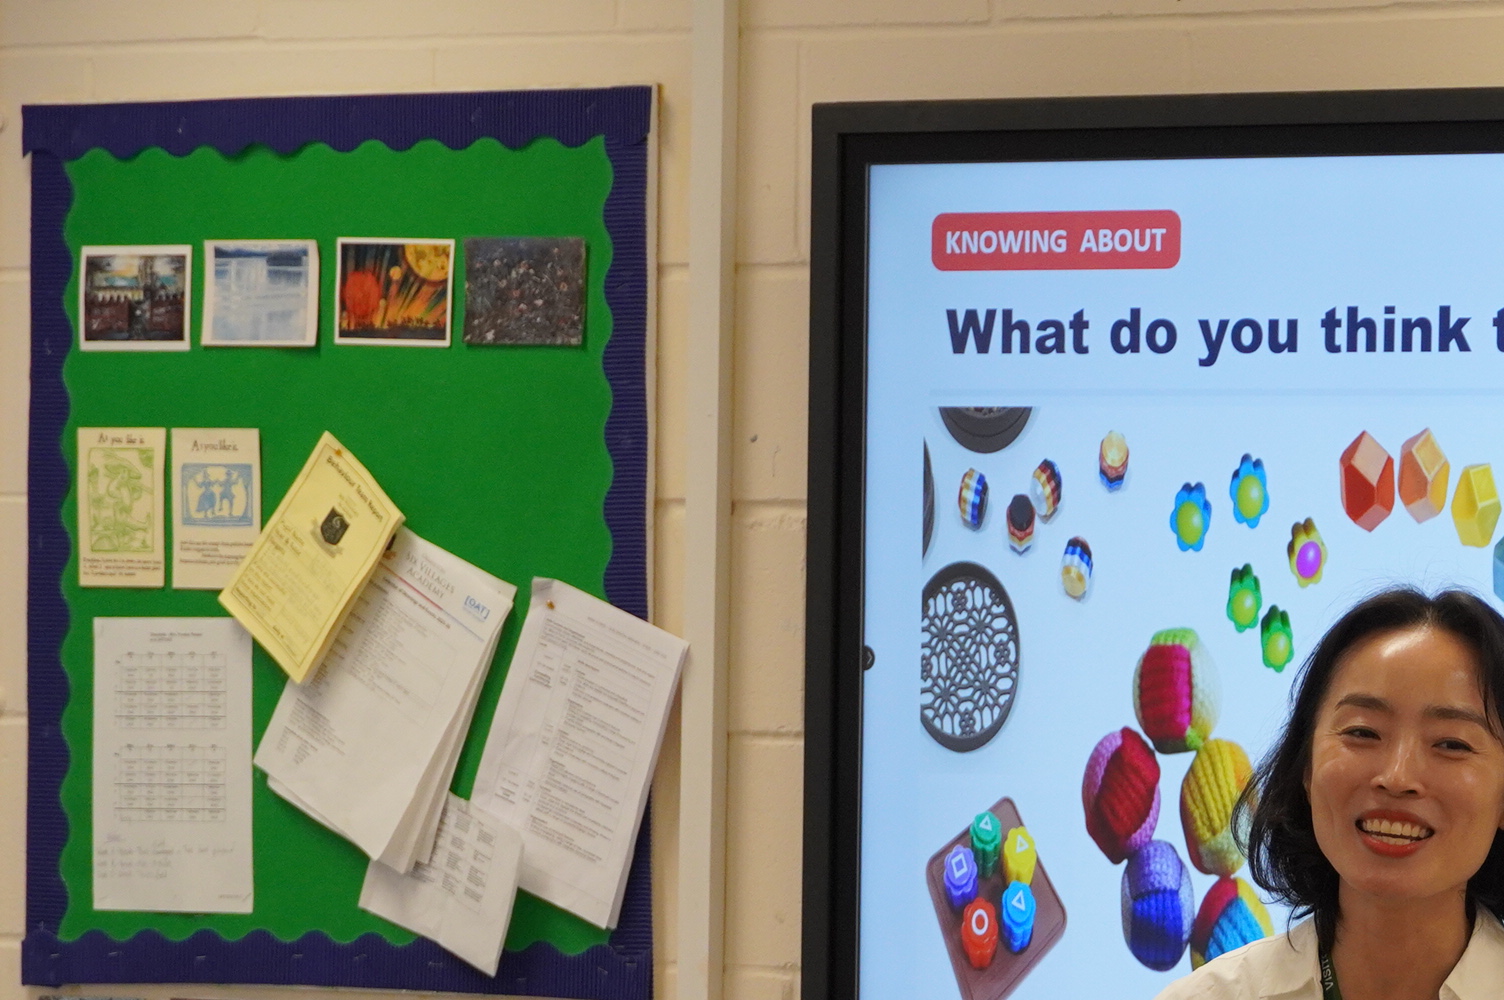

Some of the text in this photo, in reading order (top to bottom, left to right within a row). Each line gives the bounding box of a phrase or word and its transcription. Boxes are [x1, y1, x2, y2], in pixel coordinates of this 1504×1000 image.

[945, 227, 1166, 255] KNOWING ABOUT
[945, 307, 1090, 355] What
[1109, 307, 1177, 355] do
[1198, 316, 1299, 367] you
[1321, 305, 1471, 353] think
